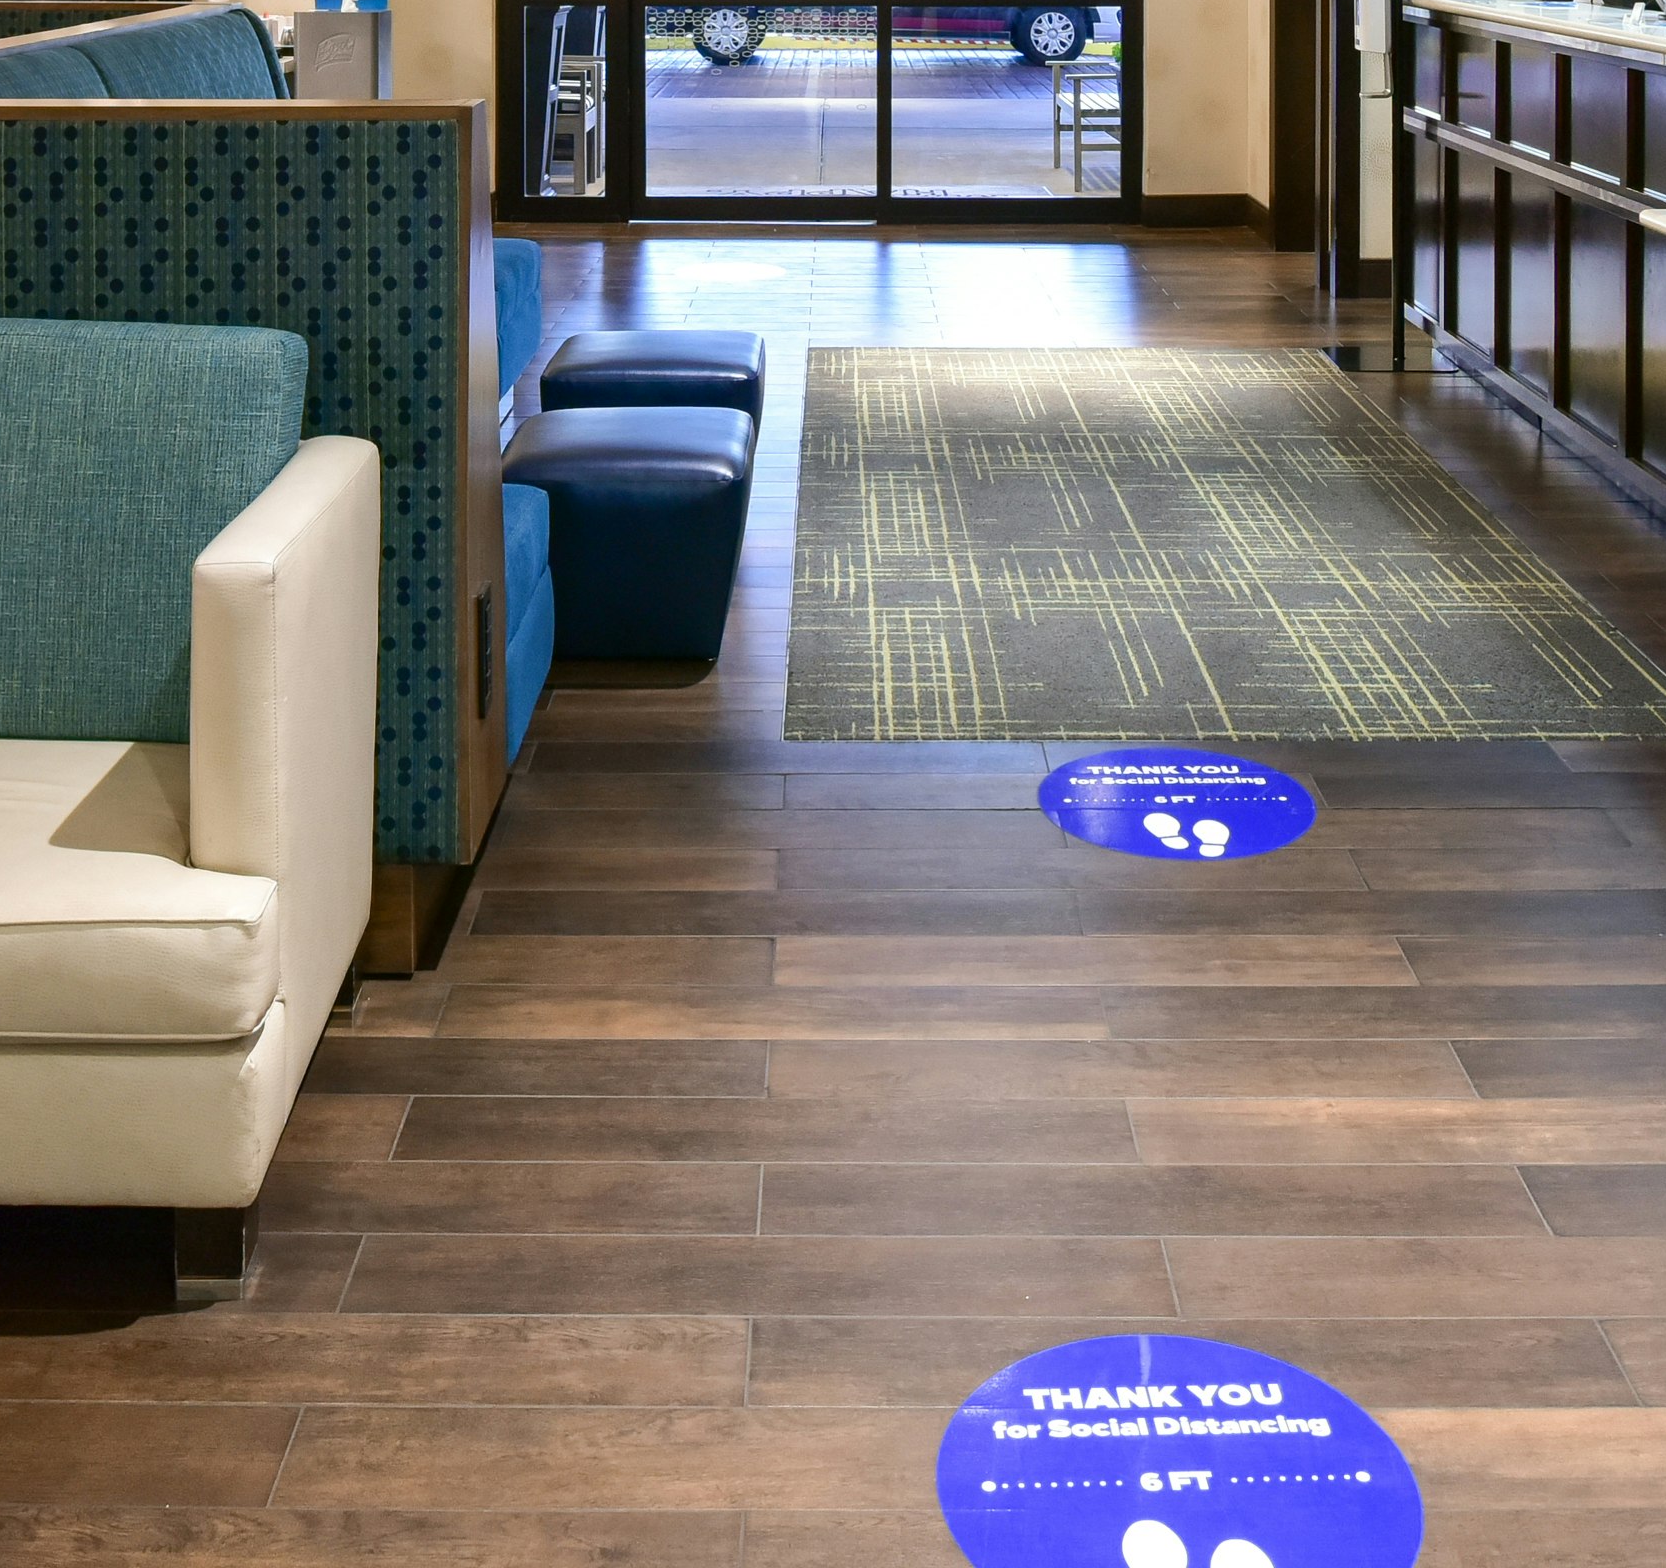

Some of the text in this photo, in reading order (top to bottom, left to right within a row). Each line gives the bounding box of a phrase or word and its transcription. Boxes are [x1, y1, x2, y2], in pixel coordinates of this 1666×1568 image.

[1087, 765, 1240, 775] THANK YOU
[1069, 776, 1266, 786] for Social Distancing
[1154, 795, 1197, 804] 6 FT
[1023, 1383, 1283, 1411] THANK YOU
[992, 1414, 1332, 1439] for Social Distancing
[1140, 1470, 1213, 1492] 6 FT
